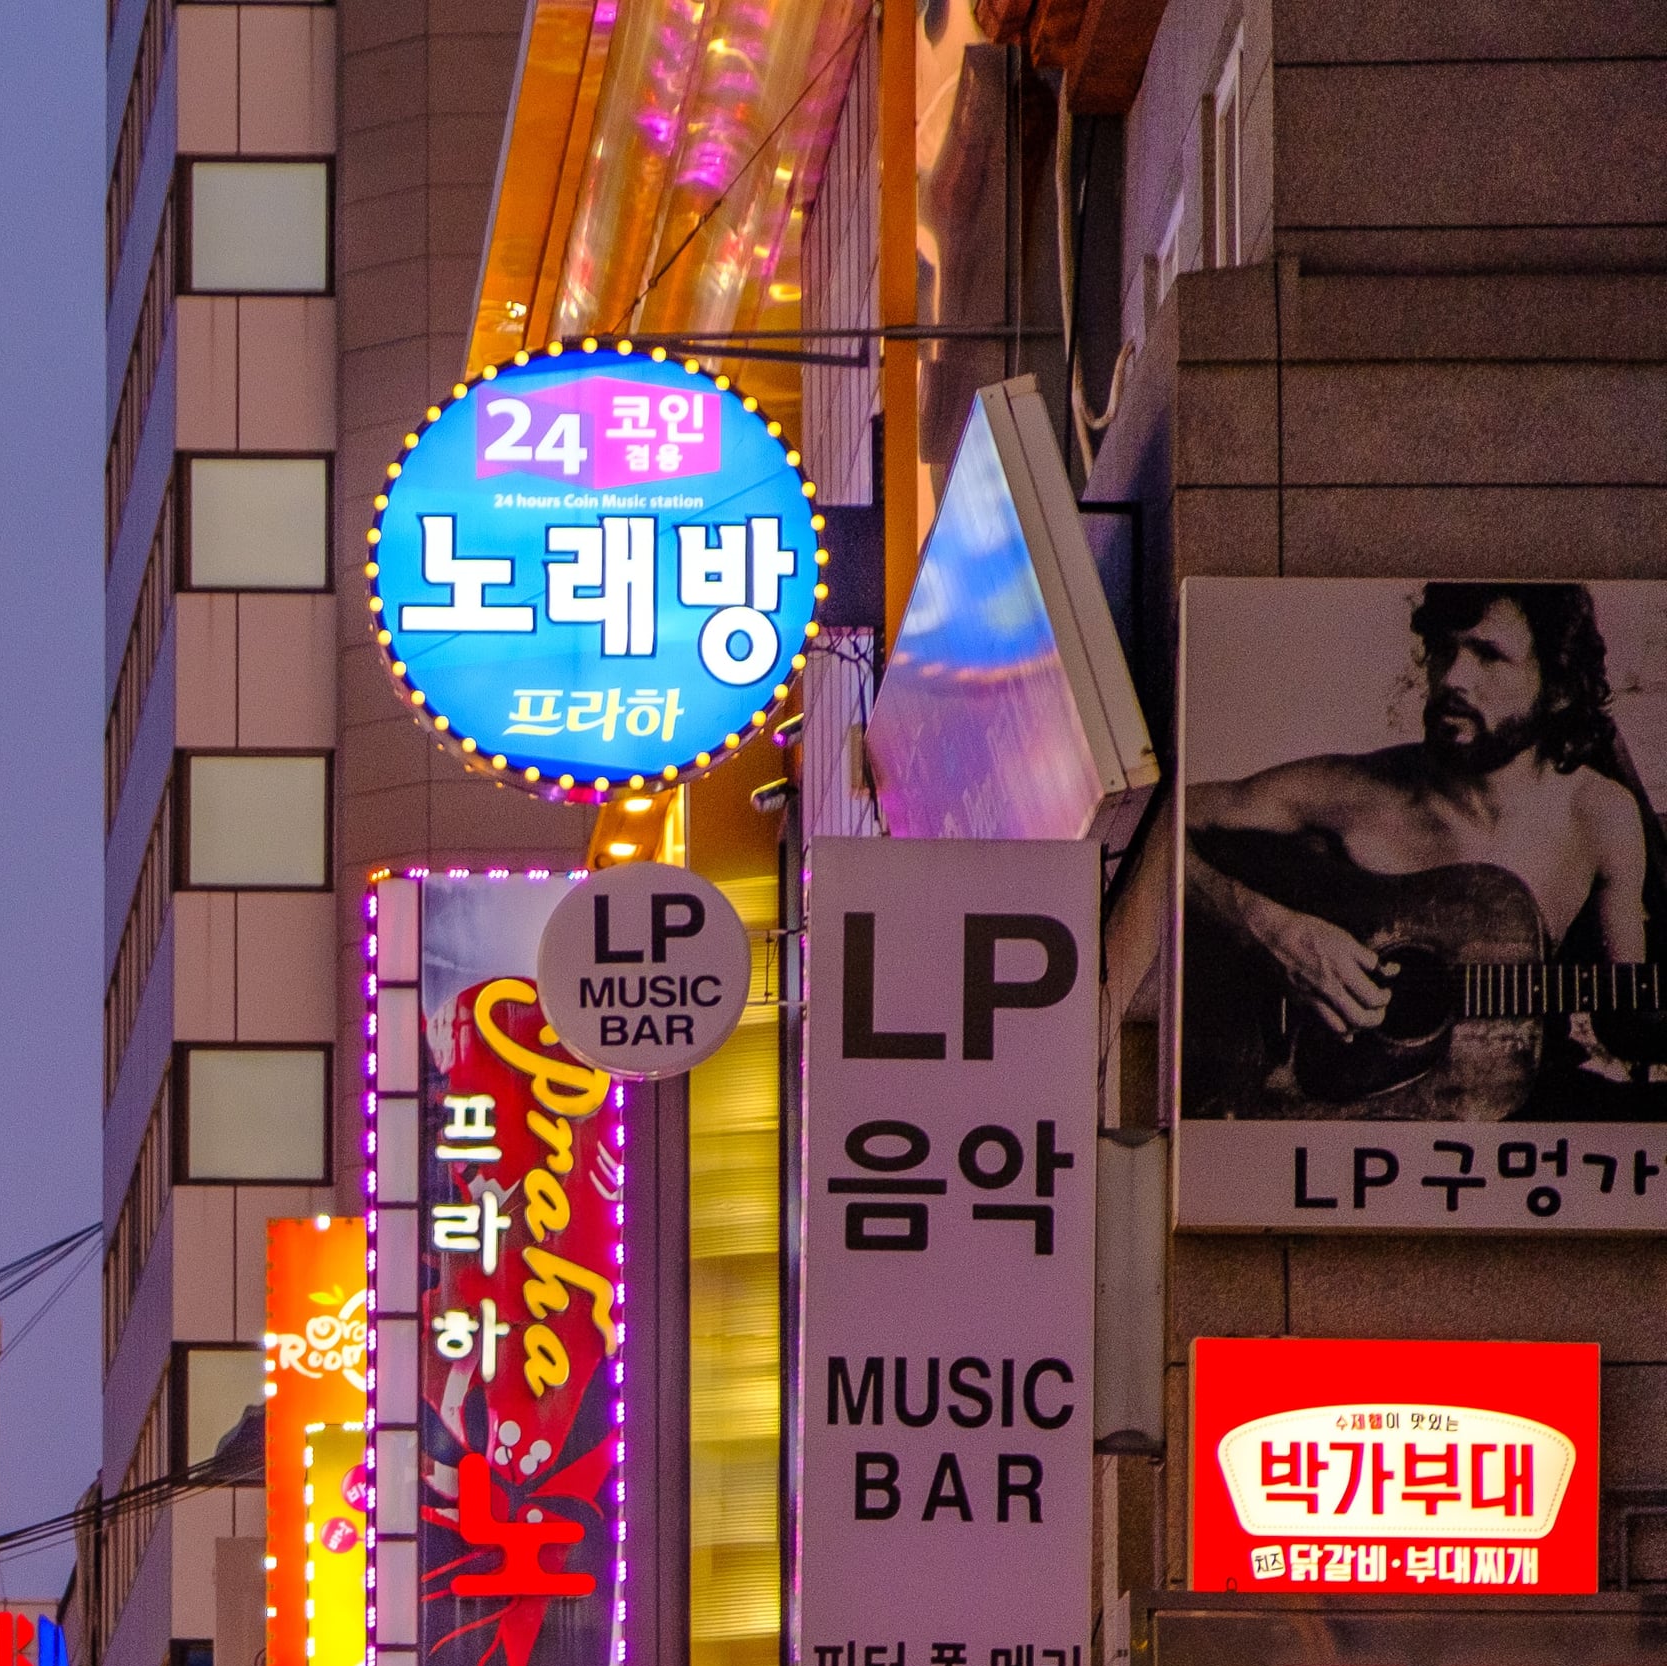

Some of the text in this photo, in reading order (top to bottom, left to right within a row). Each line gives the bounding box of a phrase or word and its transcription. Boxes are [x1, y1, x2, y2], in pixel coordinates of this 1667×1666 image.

[483, 393, 705, 476] 24 코인
[624, 443, 684, 473] 겸용
[516, 493, 562, 509] hours
[564, 493, 599, 509] Coin
[602, 493, 648, 509] Music
[650, 493, 704, 509] station
[400, 515, 797, 686] 노래방
[502, 687, 685, 742] 프라하
[592, 893, 706, 965] LP
[578, 974, 724, 1009] MUSIC
[841, 911, 1079, 1062] LP
[598, 1013, 696, 1048] BAR
[827, 1119, 1075, 1256] 음악
[1293, 1146, 1400, 1210] LP
[432, 1093, 512, 1383] 프라하
[826, 1355, 1075, 1430] MUSIC
[1335, 1411, 1460, 1433] 수제햄이 맛있는
[853, 1451, 1045, 1524] BAR
[1259, 1440, 1535, 1517] 박가부대
